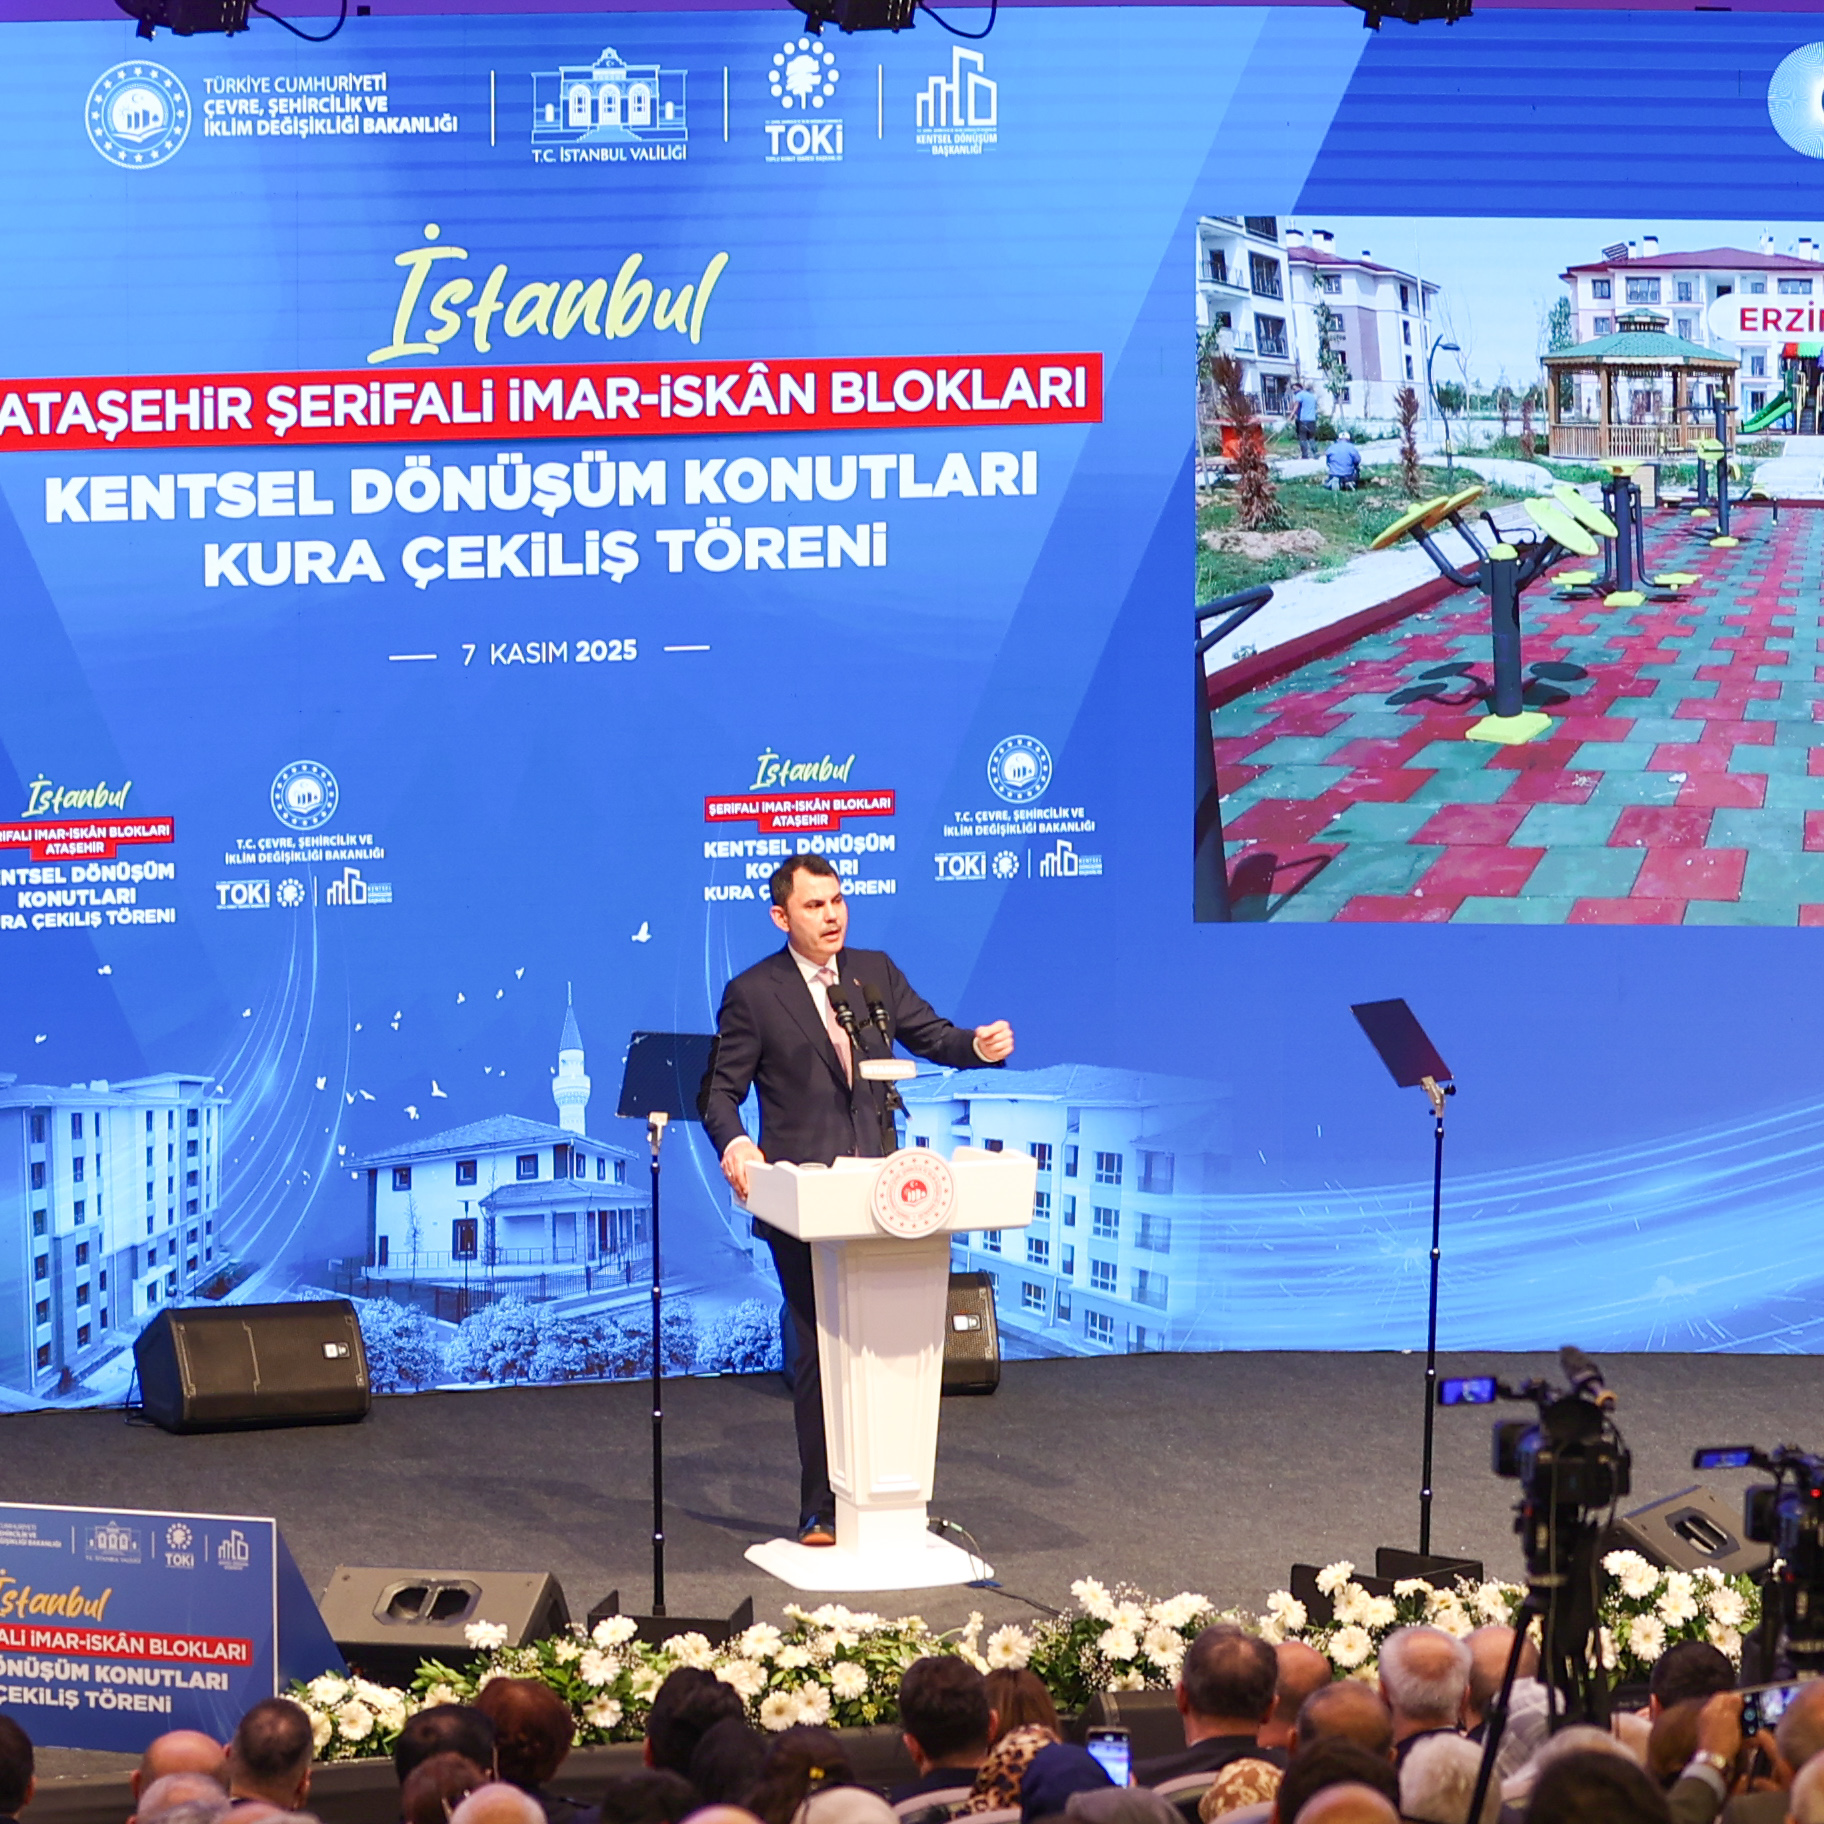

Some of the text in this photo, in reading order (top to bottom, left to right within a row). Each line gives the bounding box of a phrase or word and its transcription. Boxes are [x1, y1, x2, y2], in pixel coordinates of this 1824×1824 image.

[204, 72, 387, 94] TÜRKİYE CUMHURİYETİ
[204, 94, 388, 118] ÇEVRE, ŞEHİRCİLİK VE
[204, 114, 458, 139] İKLİM DEĞİŞİKLİĞİ BAKANLIĞI
[765, 125, 843, 155] TOKİ
[532, 144, 686, 163] T.C. İSTANBUL VALİLİĞİ
[366, 224, 729, 364] İstanbul
[266, 379, 493, 437] ŞERİFALİ
[508, 362, 816, 422] İMAR-İSKÂN
[831, 366, 1086, 414] BLOKLARI
[45, 450, 1038, 523] KENTSEL DÖNÜŞÜM KONUTLARI
[204, 517, 887, 590] KURA ÇEKİLİŞ TÖRENİ
[461, 639, 637, 666] 7 KASIM 2025
[749, 747, 856, 791] İstanbul
[21, 773, 132, 818] İstanbul
[833, 797, 891, 810] BLOKLARI
[955, 807, 1084, 823] T.C. ÇEVRE, ŞEHİRCİLİK VE
[109, 824, 170, 838] BLOKLARI
[944, 820, 1095, 837] İKLİM DEĞİŞİKLİĞİ BAKANLIĞI
[236, 834, 373, 850] T.C. ÇEVRE, ŞEHİRCİLİK VE
[704, 833, 895, 858] KENTSEL DÖNÜŞÜM
[225, 847, 385, 865] İKLİM DEĞİŞİKLİĞİ BAKANLIĞI
[71, 861, 175, 883] DÖNÜŞÜM
[18, 888, 136, 908] KONUTLARI
[704, 886, 755, 901] KURA
[30, 1630, 144, 1655] İMAR-İSKÂN
[149, 1636, 246, 1661] BLOKLARI
[95, 1666, 229, 1691] KONUTLARI
[85, 1689, 171, 1713] TÖRENİ
